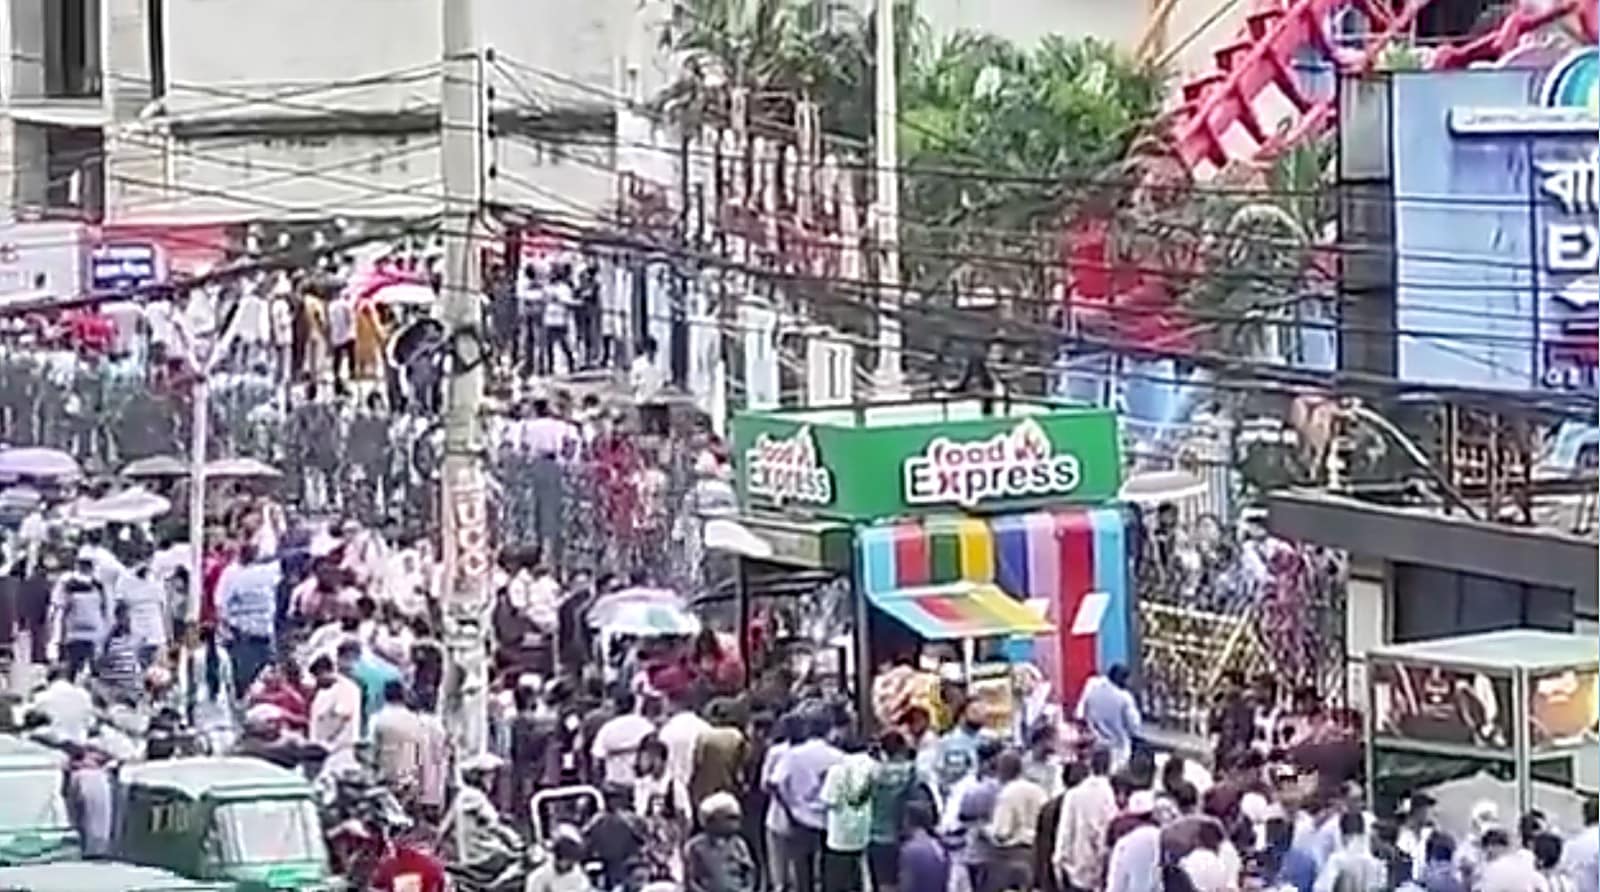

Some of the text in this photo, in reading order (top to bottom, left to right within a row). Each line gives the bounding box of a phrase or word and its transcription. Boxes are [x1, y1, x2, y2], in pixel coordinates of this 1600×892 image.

[933, 440, 1005, 466] food
[749, 455, 827, 500] Express
[910, 460, 1075, 500] Express
